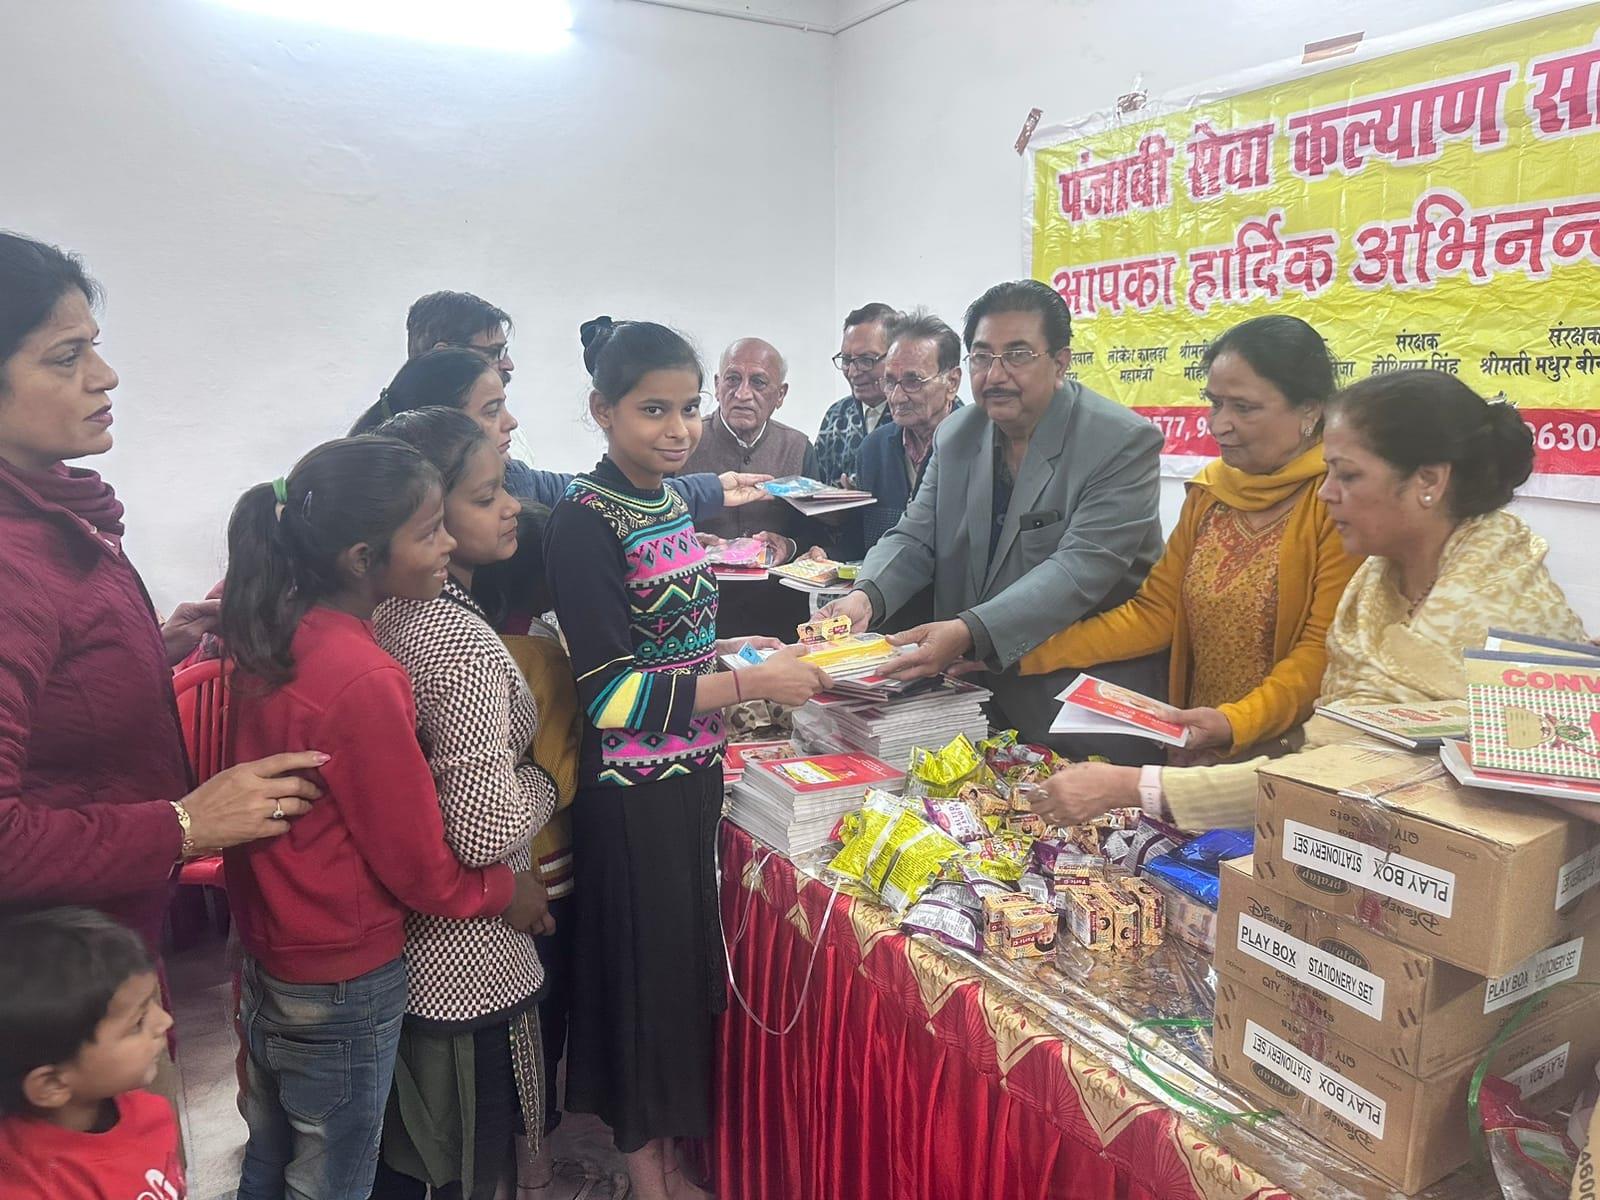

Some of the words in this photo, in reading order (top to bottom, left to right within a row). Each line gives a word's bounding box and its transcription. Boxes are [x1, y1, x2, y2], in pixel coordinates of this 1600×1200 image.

[1059, 135, 1174, 221] पंजाबी
[1187, 122, 1274, 198] सेवा
[1289, 69, 1511, 176] कल्याण
[1053, 257, 1175, 314] आपका
[1186, 213, 1335, 311] हार्दिक
[1480, 350, 1531, 376] श्रीमती
[1535, 355, 1572, 382] मधुर
[1293, 836, 1308, 860] SET
[1309, 845, 1363, 874] STATIONERY
[1373, 860, 1405, 887] BOX
[1407, 874, 1449, 903] PLAY
[1240, 925, 1271, 951] PLAY
[1272, 941, 1297, 966] BOX
[1308, 956, 1356, 993] STATIONERY
[1357, 981, 1374, 1003] SET
[1488, 974, 1512, 1000] PLAY
[1252, 1036, 1267, 1056] SET
[1266, 1047, 1312, 1084] STATIONERY
[1318, 1074, 1345, 1102] BOX
[1347, 1095, 1381, 1125] PLAY
